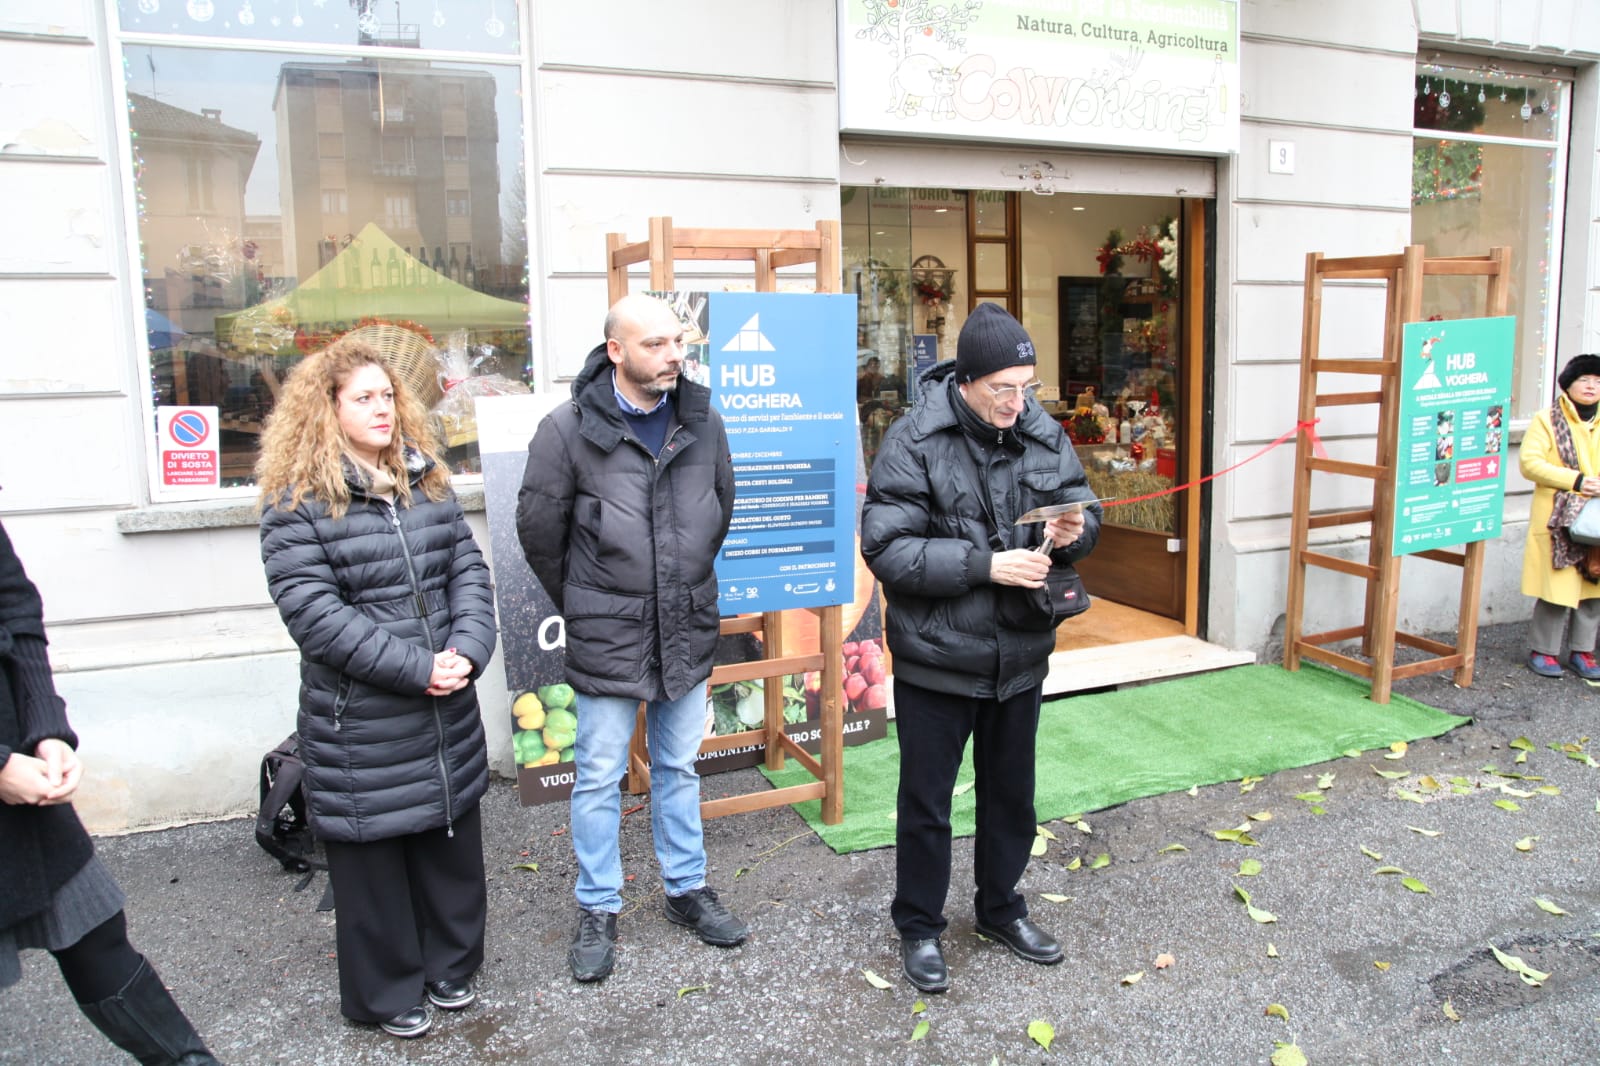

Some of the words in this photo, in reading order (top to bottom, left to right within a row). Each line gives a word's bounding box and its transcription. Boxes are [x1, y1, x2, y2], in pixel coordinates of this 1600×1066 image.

[1017, 14, 1076, 37] Natura,
[1081, 22, 1142, 44] Cultura,
[1147, 29, 1228, 52] Agricoltura
[1280, 147, 1287, 165] 9
[1446, 352, 1476, 371] HUB
[720, 364, 776, 387] HUB
[1445, 372, 1488, 387] VOGHERA
[719, 393, 803, 409] VOGHERA
[740, 413, 748, 422] di
[748, 413, 769, 422] servizi
[770, 414, 781, 423] per
[823, 411, 844, 420] sociale
[171, 452, 209, 460] DIVIETO
[733, 464, 772, 472] AUGURAZIONE
[785, 462, 811, 470] VOGHERA
[734, 497, 765, 505] BORATORIO
[730, 516, 762, 524] ABORATORI
[768, 545, 804, 554] FORMAZIONE
[788, 731, 809, 744] IBO
[697, 743, 757, 760] OMUNITA
[540, 772, 576, 787] VUOI
